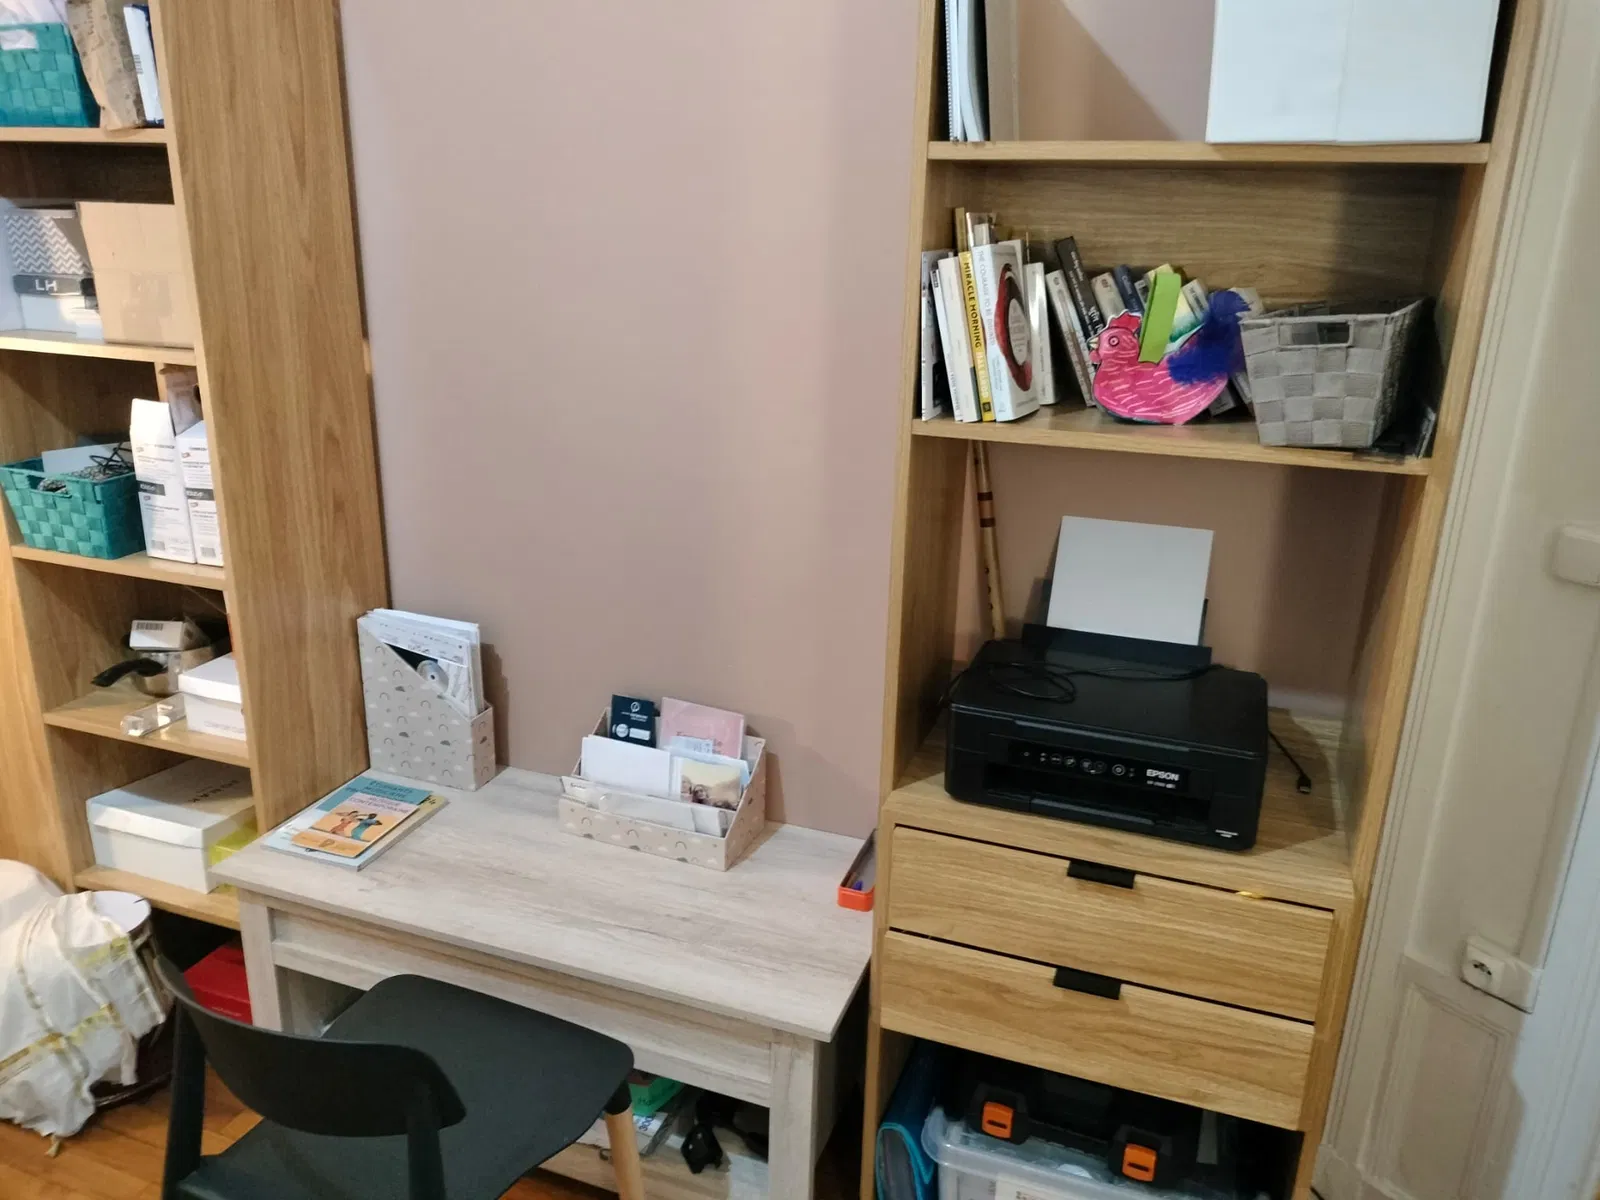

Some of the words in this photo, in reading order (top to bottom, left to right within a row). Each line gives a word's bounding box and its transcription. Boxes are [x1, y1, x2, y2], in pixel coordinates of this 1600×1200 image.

[963, 262, 977, 302] MIRACLE
[969, 304, 983, 348] MORNING
[1146, 769, 1180, 781] EPSON
